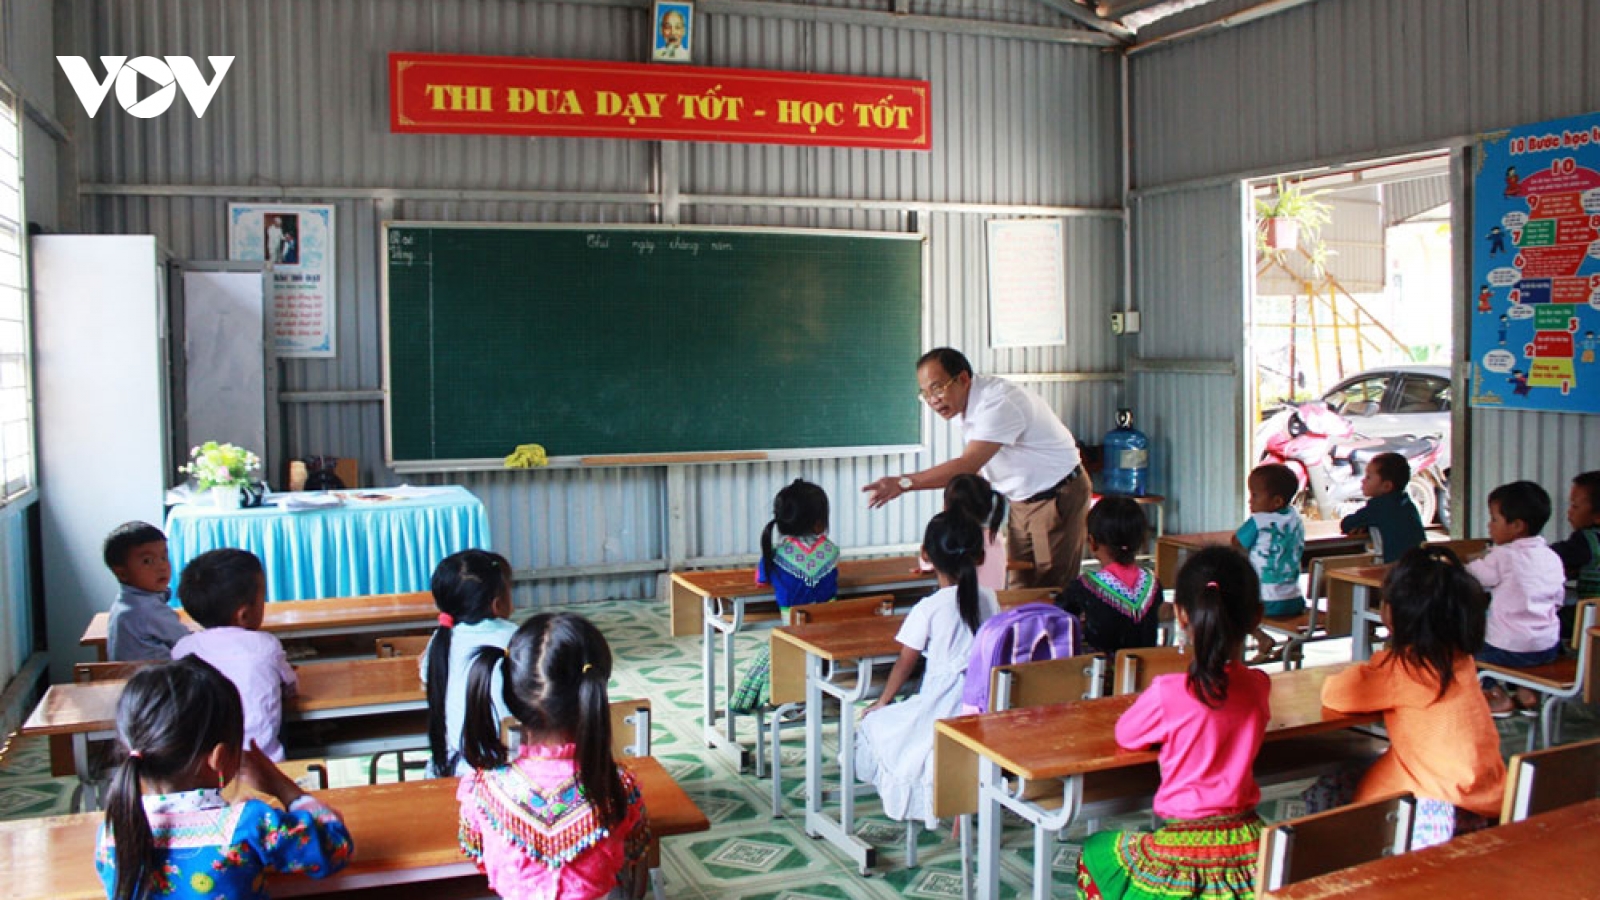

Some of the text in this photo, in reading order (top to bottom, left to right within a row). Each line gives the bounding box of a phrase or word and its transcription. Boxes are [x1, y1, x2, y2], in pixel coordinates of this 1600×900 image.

[426, 83, 493, 112] THI
[507, 87, 583, 115] ĐUA
[596, 90, 667, 125] DẠY
[677, 84, 744, 121] TỐT
[777, 99, 845, 133] HỌC
[853, 94, 913, 129] TỐT
[1510, 138, 1525, 155] 10
[1528, 133, 1560, 153] Bước
[1563, 130, 1589, 150] học
[1552, 158, 1575, 175] 10
[1512, 230, 1522, 245] 7
[1508, 289, 1520, 304] 4
[1524, 344, 1536, 358] 2
[1561, 380, 1569, 394] 1
